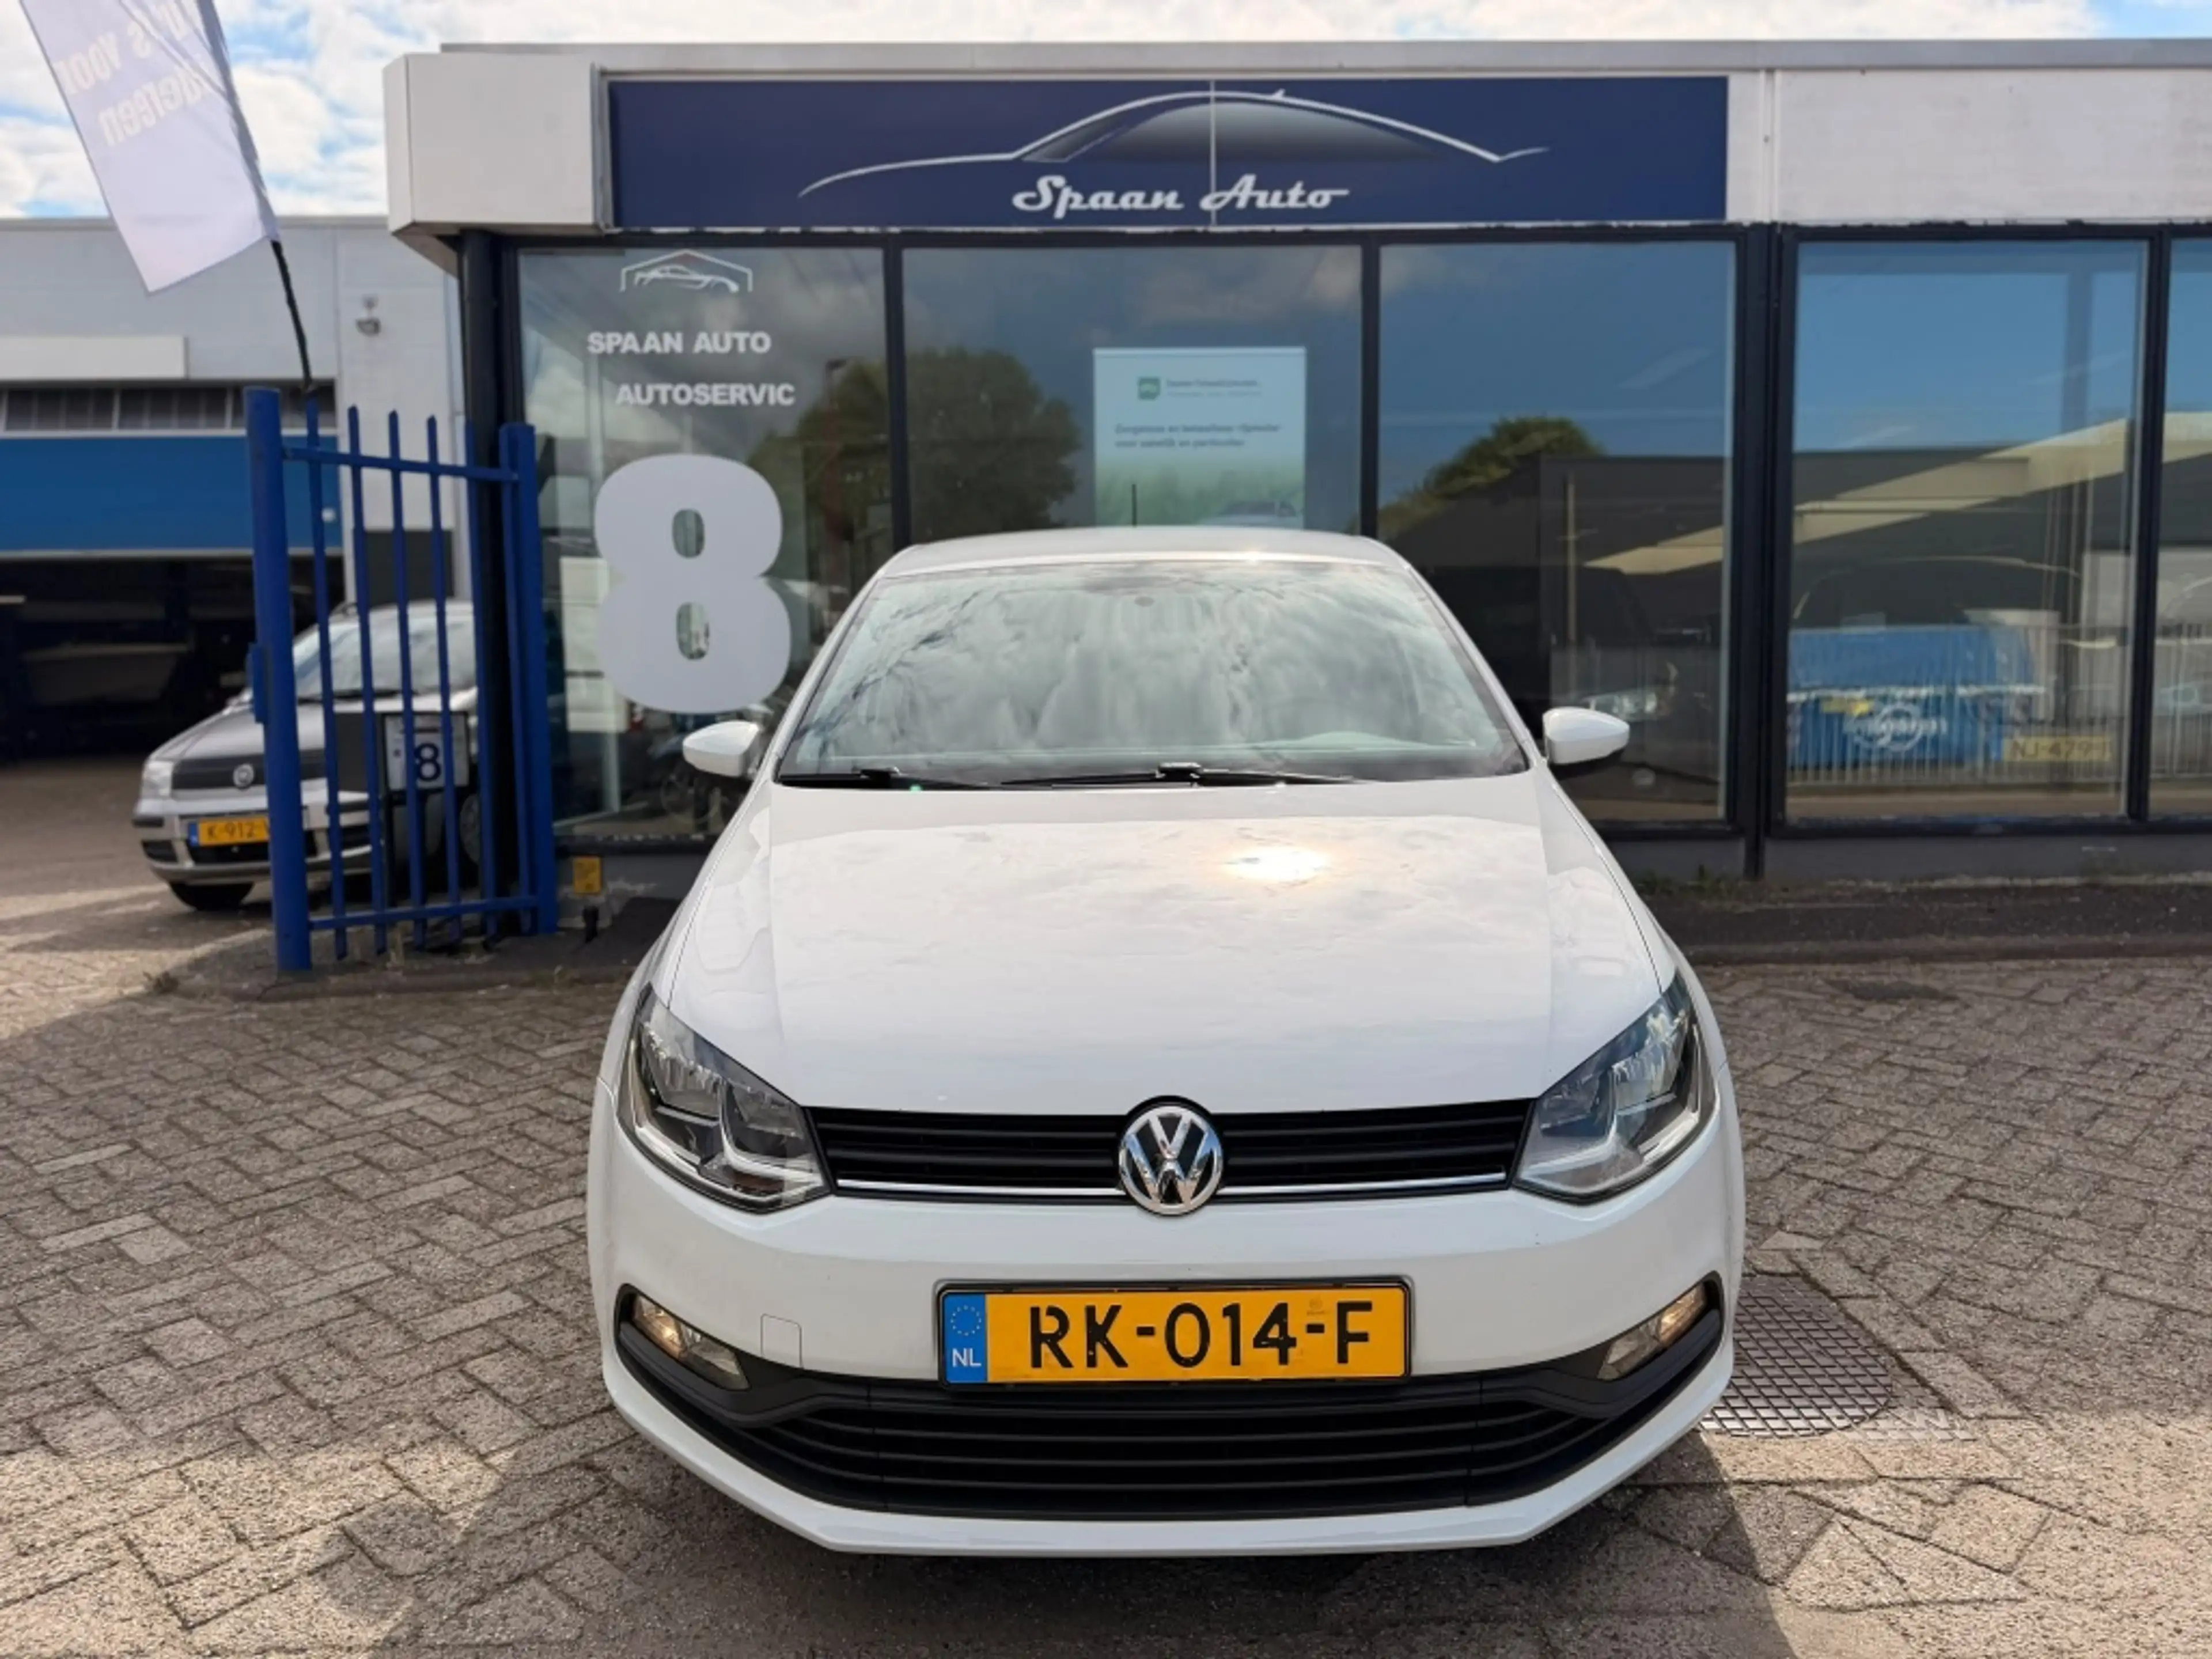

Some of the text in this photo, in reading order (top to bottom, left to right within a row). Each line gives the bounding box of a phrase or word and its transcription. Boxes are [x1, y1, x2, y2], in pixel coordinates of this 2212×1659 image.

[1012, 174, 1350, 219] Spaan Auto
[587, 332, 771, 354] SPAAN AUTO
[616, 382, 796, 406] AUTOSERVIC
[594, 453, 791, 714] 8
[414, 743, 441, 782] 8
[1030, 1301, 1373, 1369] RK-014-F
[952, 1347, 982, 1368] NL
